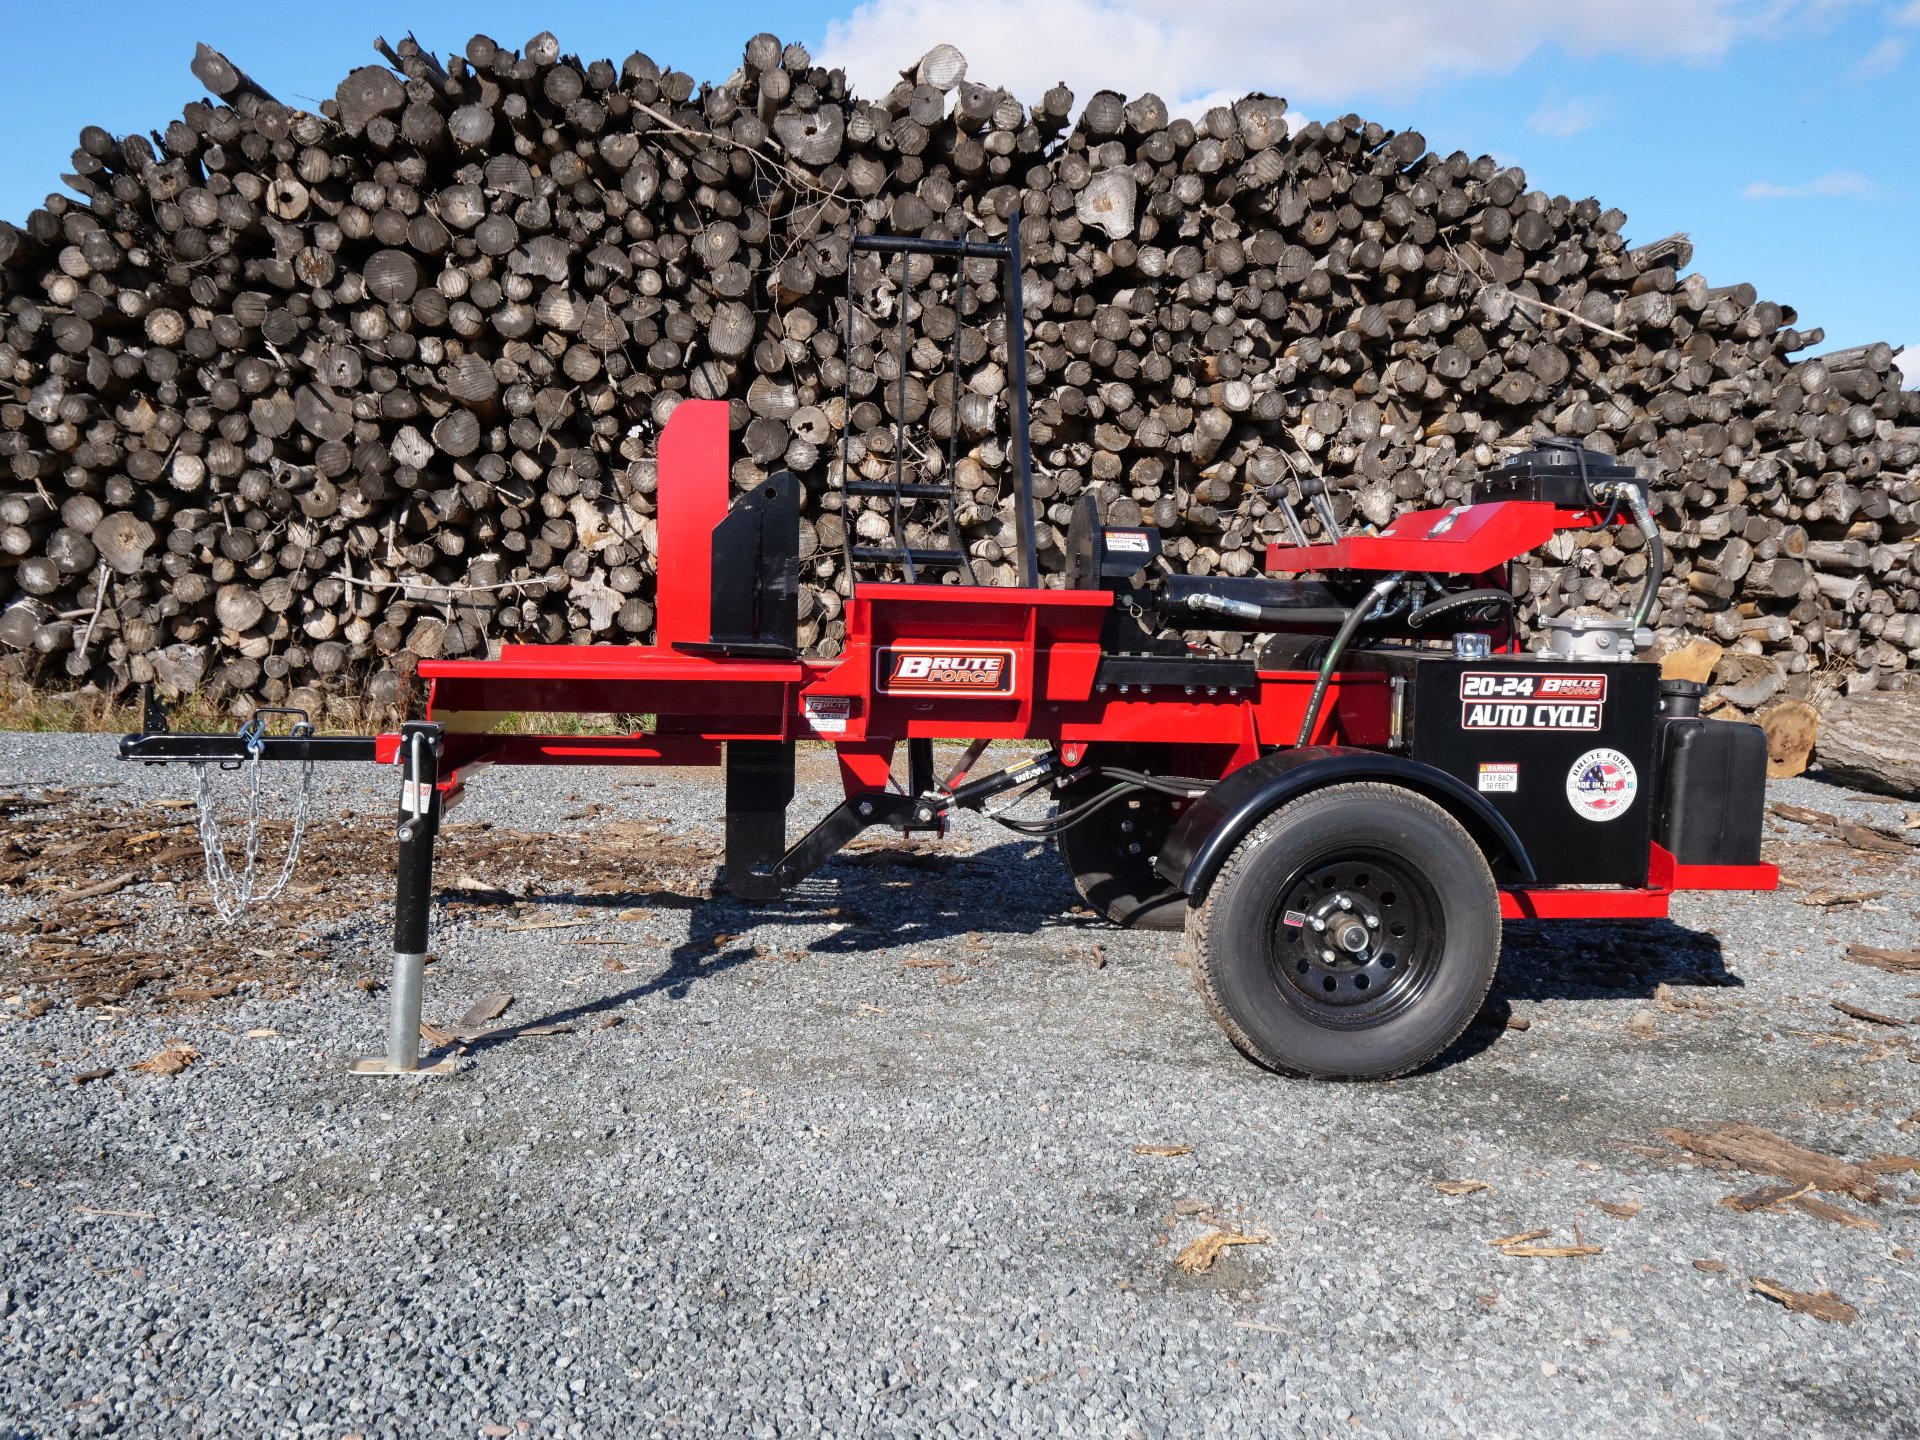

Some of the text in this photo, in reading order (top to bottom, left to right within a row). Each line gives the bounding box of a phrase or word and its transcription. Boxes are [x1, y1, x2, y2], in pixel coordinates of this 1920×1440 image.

[897, 656, 1002, 678] BRUTE
[927, 669, 1000, 682] FORCE
[1463, 677, 1534, 696] 20-24
[1541, 679, 1602, 692] BRUTE
[1558, 686, 1602, 696] FORCE
[811, 702, 849, 711] BRUTE
[1467, 704, 1598, 728] AUTO CYCLE
[1487, 764, 1518, 773] WARNING
[1572, 751, 1602, 777] BRUTE
[1607, 752, 1632, 777] FORCE
[1482, 774, 1515, 782] STAY BACK
[1486, 782, 1510, 790] 50 FEET
[1570, 781, 1590, 789] MADE
[1592, 781, 1601, 789] IN
[1602, 781, 1616, 789] THE
